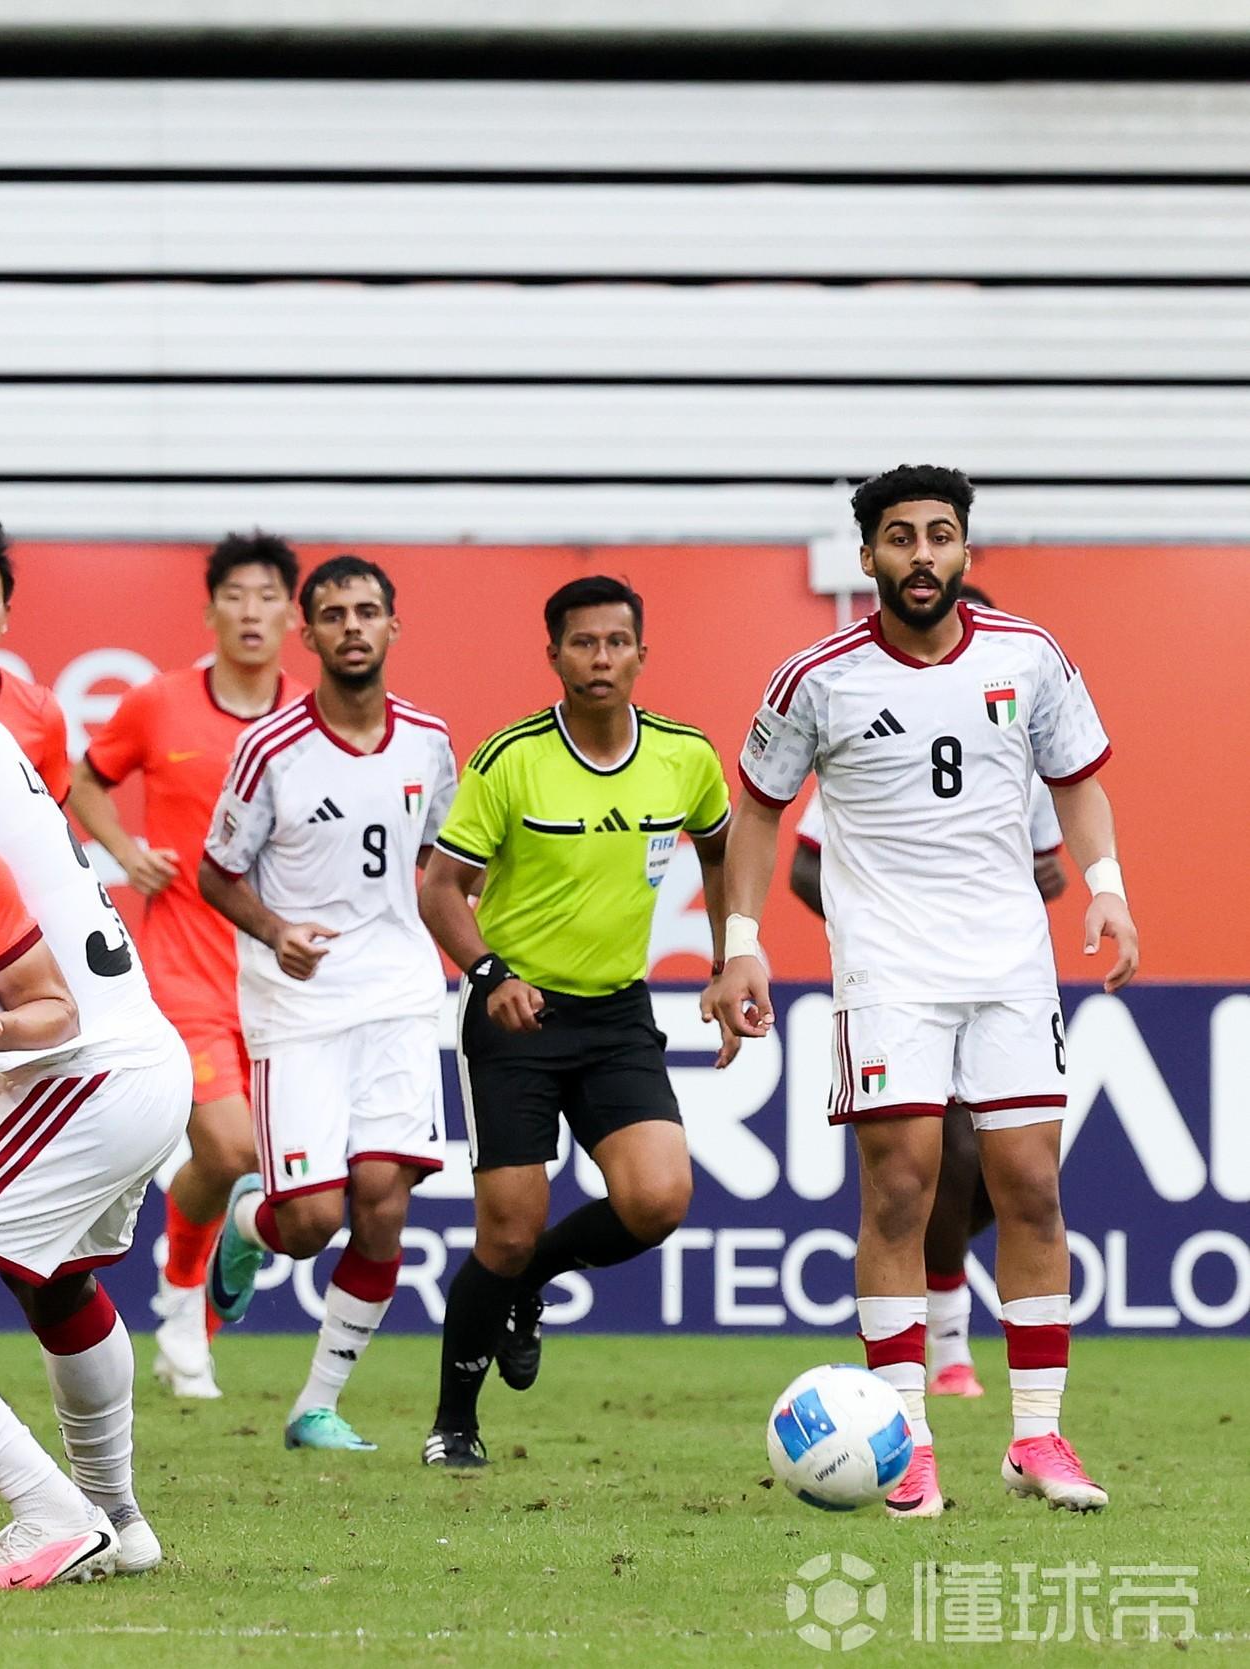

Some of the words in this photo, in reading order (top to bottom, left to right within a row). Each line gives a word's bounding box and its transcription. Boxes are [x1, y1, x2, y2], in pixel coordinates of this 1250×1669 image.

[931, 735, 963, 799] 8
[362, 823, 388, 879] 9
[650, 835, 675, 852] FIFA
